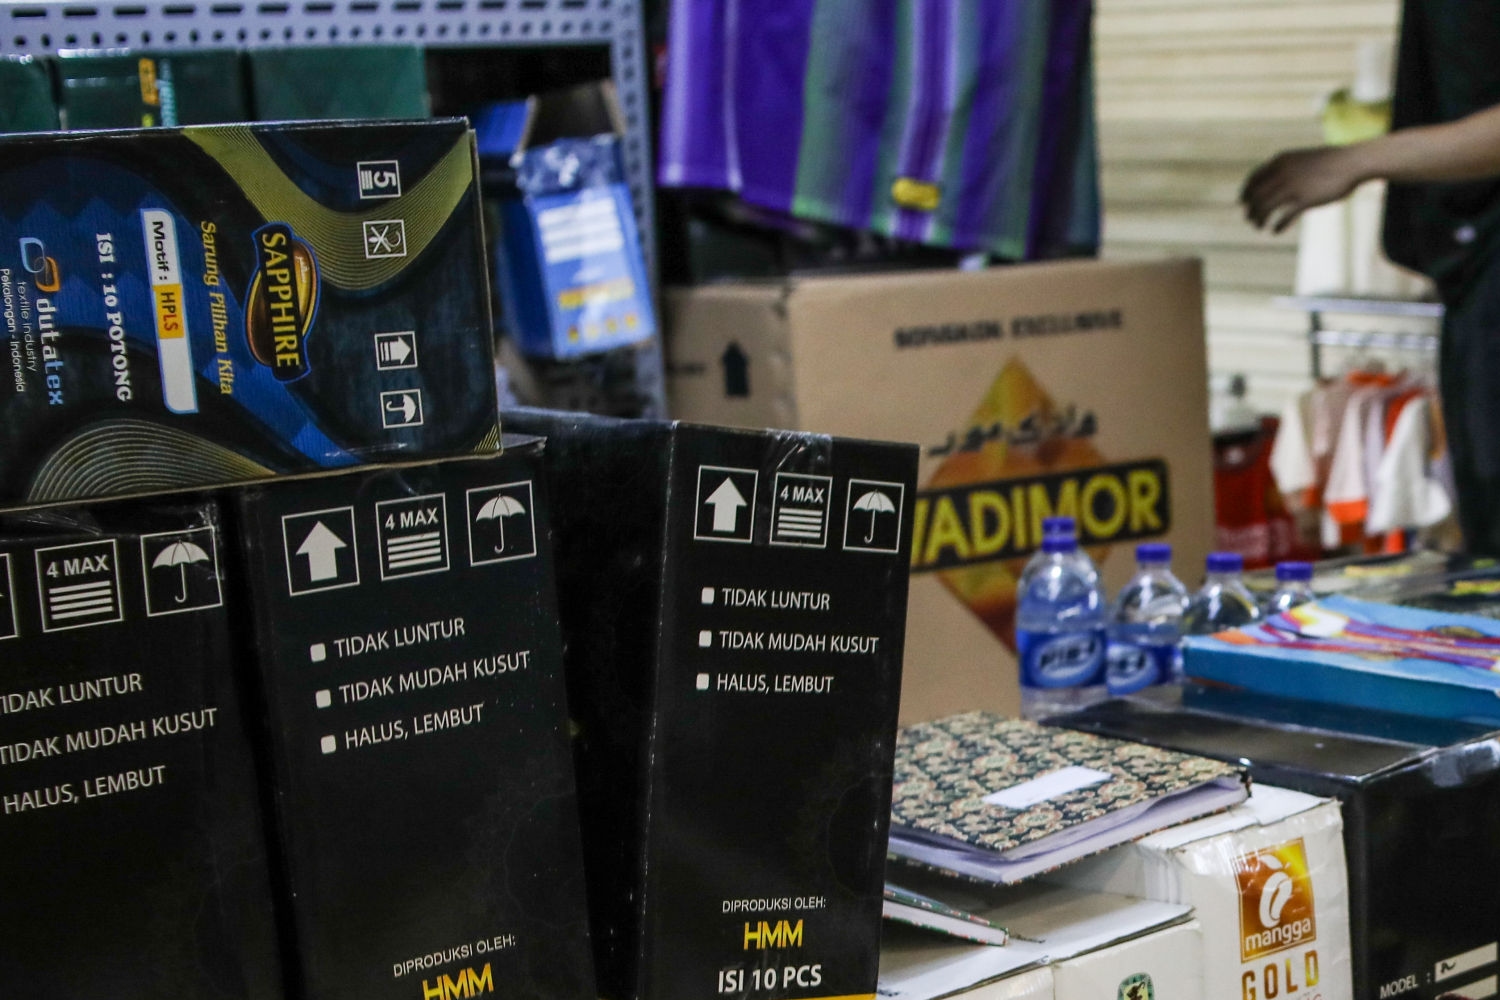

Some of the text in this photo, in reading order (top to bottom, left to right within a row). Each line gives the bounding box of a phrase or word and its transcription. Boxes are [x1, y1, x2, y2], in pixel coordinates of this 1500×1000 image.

[373, 171, 395, 187] 5
[96, 233, 115, 263] ISI
[152, 221, 170, 272] Motif
[17, 281, 30, 320] textile
[103, 284, 118, 308] 10
[160, 291, 179, 332] HPLS
[201, 221, 235, 394] Sarung Pilihan Kita
[262, 233, 300, 367] SAPPHIRE
[0, 268, 17, 333] Pekalongan
[10, 341, 26, 393] Indonesia
[36, 298, 64, 405] dutatex
[106, 312, 133, 402] POTONG
[780, 485, 825, 503] 4 MAX
[385, 507, 439, 530] 4 MAX
[911, 470, 1162, 566] ADIMOR
[46, 554, 111, 578] 4 MAX
[722, 587, 831, 611] TIDAK LUNTUR
[333, 617, 466, 658] TIDAK LUNTUR
[719, 631, 879, 654] TIDAK MUDAH KUSUT
[59, 673, 144, 705] LUNTUR
[339, 650, 531, 705] TIDAK MUDAH KUSUT
[717, 673, 834, 694] HALUS, LEMBUT
[0, 708, 218, 765] TIDAK MUDAH KUSUT
[345, 703, 485, 750] HALUS, LEMBUT
[3, 765, 166, 815] HALUS, LEMBUT
[722, 896, 826, 913] DIPRODUKSI OLEH:
[743, 919, 804, 950] HMM
[1245, 918, 1312, 952] mangga
[393, 933, 516, 977] DIPRODUKSI OLEH:
[718, 964, 822, 993] ISI 10 PCS
[1380, 974, 1418, 999] MODEL
